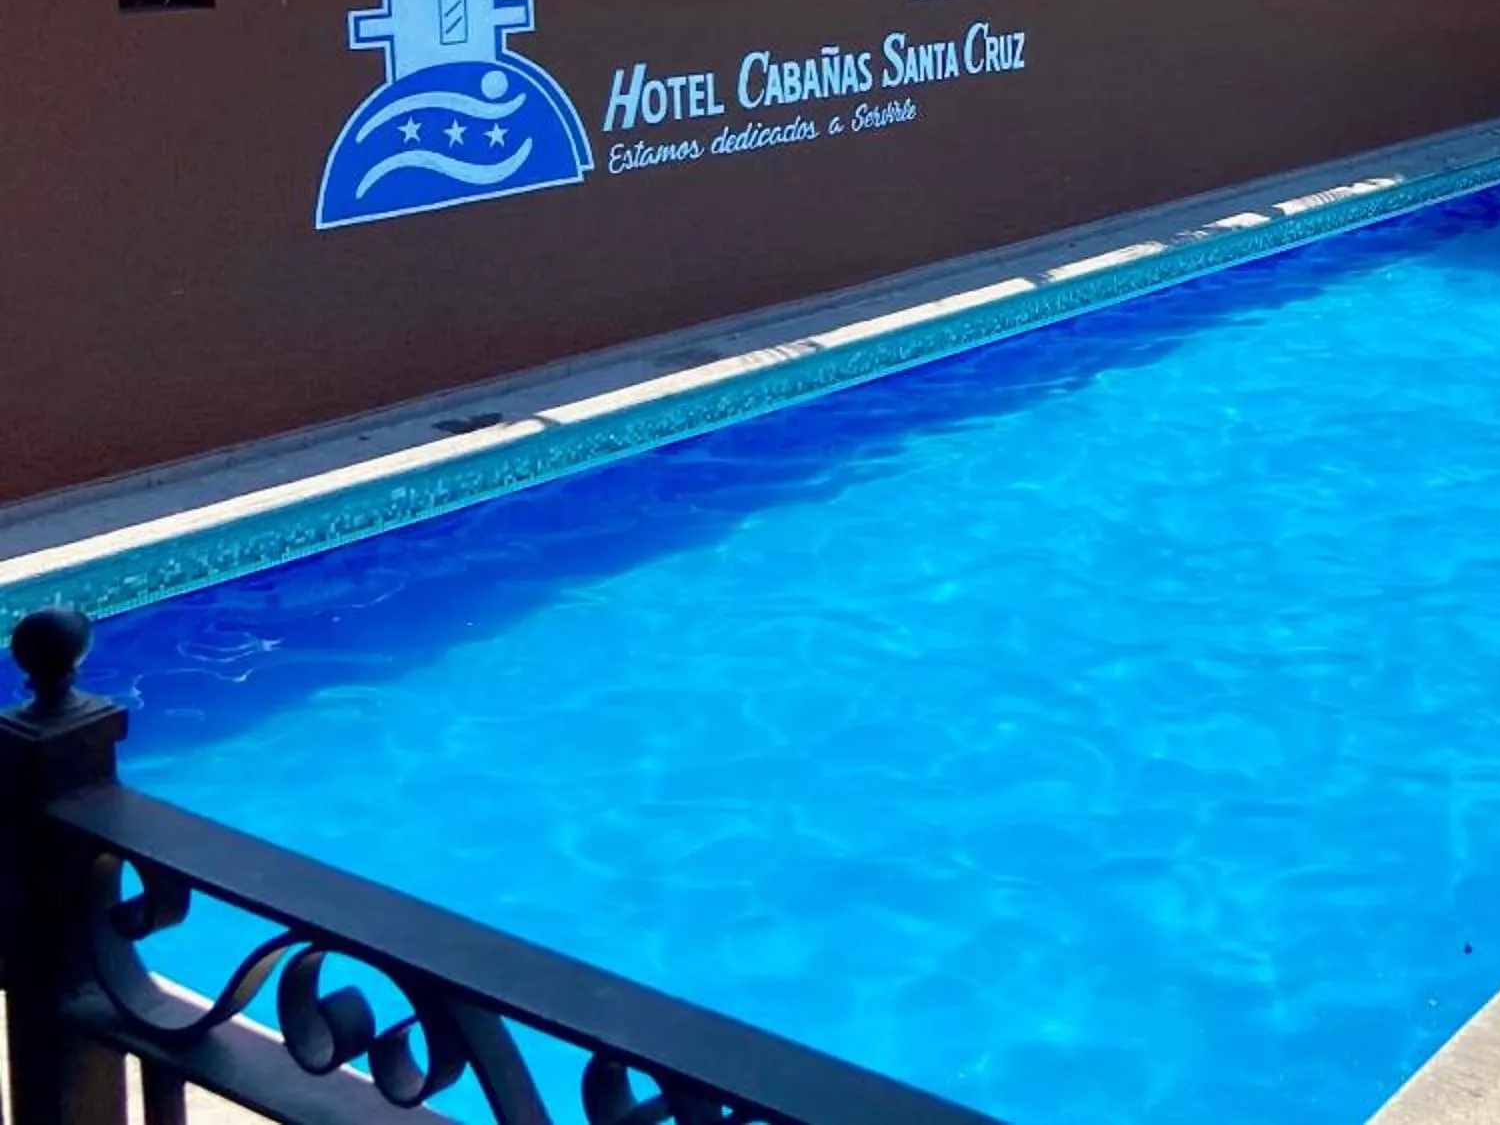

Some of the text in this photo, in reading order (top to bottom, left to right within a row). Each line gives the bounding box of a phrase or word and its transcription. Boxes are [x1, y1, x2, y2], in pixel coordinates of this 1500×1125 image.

[602, 20, 1026, 133] HOTEL CABAÑAS SANTA CRUZ
[607, 139, 703, 175] Estamos
[710, 115, 820, 156] dedicados
[828, 118, 844, 135] a
